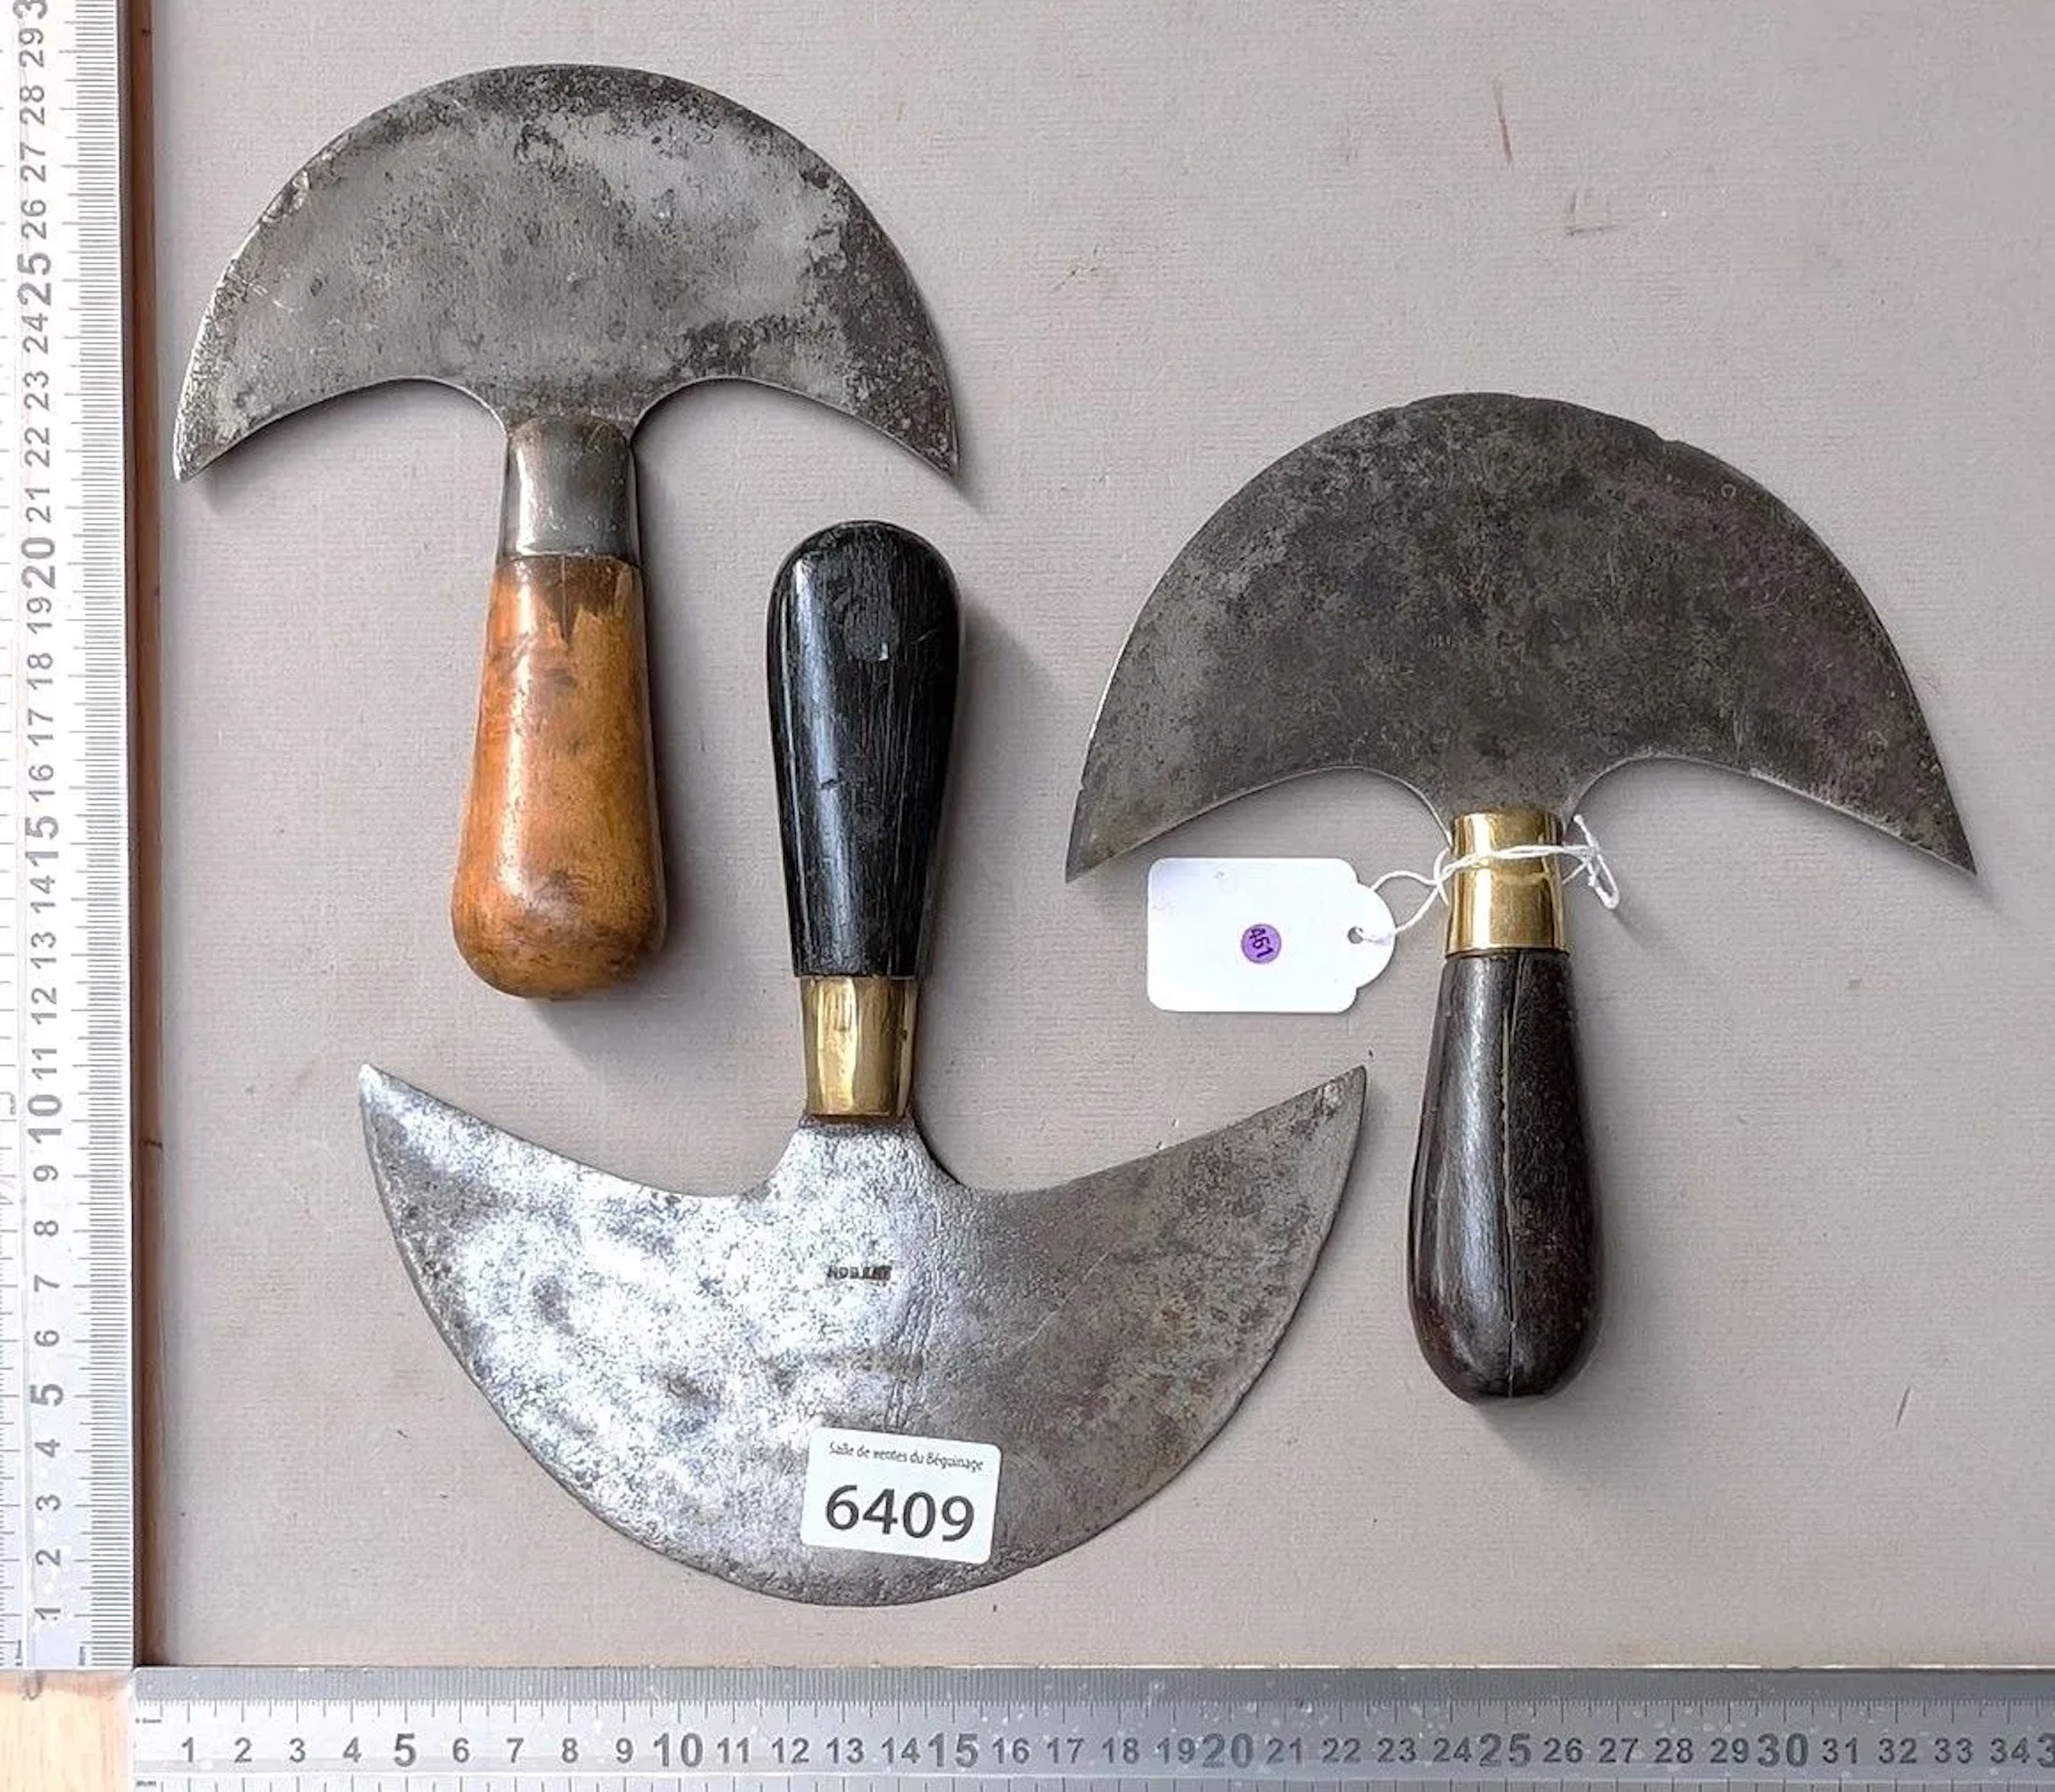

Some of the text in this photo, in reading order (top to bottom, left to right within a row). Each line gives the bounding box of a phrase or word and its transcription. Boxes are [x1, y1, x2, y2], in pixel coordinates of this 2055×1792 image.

[18, 28, 44, 67] 29
[19, 86, 45, 125] 28
[20, 141, 46, 182] 27
[20, 200, 46, 240] 26
[17, 253, 51, 306] 25
[21, 313, 48, 354] 24
[22, 371, 49, 411] 23
[24, 428, 50, 467] 22
[25, 488, 51, 523] 21
[21, 537, 56, 589] 20
[26, 597, 52, 634] 19
[26, 653, 53, 690] 18
[27, 708, 54, 746] 17
[28, 765, 55, 802] 16
[25, 816, 59, 867] 15
[29, 875, 56, 913] 14
[30, 932, 56, 969] 13
[31, 987, 57, 1025] 12
[32, 1049, 57, 1080] 11
[27, 1095, 62, 1144] 10
[33, 1165, 58, 1182] 9
[34, 1221, 58, 1237] 8
[34, 1275, 59, 1292] 7
[34, 1330, 59, 1347] 6
[29, 1384, 64, 1406] 5
[34, 1439, 60, 1458] 4
[857, 1443, 870, 1457] de
[910, 1449, 924, 1464] du
[35, 1494, 61, 1511] 3
[826, 1485, 975, 1542] 6409
[35, 1550, 60, 1566] 2
[34, 1608, 61, 1620] 1
[181, 1737, 193, 1763] 1
[234, 1737, 252, 1763] 2
[290, 1738, 306, 1764] 3
[343, 1737, 362, 1763] 4
[394, 1733, 416, 1767] 5
[453, 1737, 469, 1763] 6
[507, 1738, 523, 1763] 7
[562, 1738, 579, 1763] 8
[616, 1738, 633, 1764] 9
[653, 1733, 703, 1767] 10
[717, 1737, 748, 1764] 11
[772, 1737, 809, 1764] 12
[827, 1737, 864, 1764] 13
[882, 1737, 920, 1764] 14
[928, 1733, 978, 1768] 15
[992, 1738, 1029, 1764] 16
[1047, 1737, 1084, 1763] 17
[1102, 1737, 1139, 1764] 18
[1157, 1737, 1195, 1764] 19
[1202, 1733, 1254, 1768] 20
[1267, 1737, 1302, 1764] 21
[1323, 1738, 1360, 1763] 22
[1377, 1737, 1416, 1763] 23
[1434, 1737, 1472, 1763] 24
[1479, 1733, 1532, 1767] 25
[1543, 1737, 1583, 1763] 26
[1599, 1738, 1638, 1764] 27
[1654, 1738, 1693, 1763] 28
[1710, 1738, 1749, 1763] 29
[1757, 1733, 1808, 1767] 30
[1822, 1737, 1857, 1764] 31
[1879, 1738, 1916, 1764] 32
[1935, 1738, 1973, 1764] 33
[1990, 1737, 2030, 1764] 34
